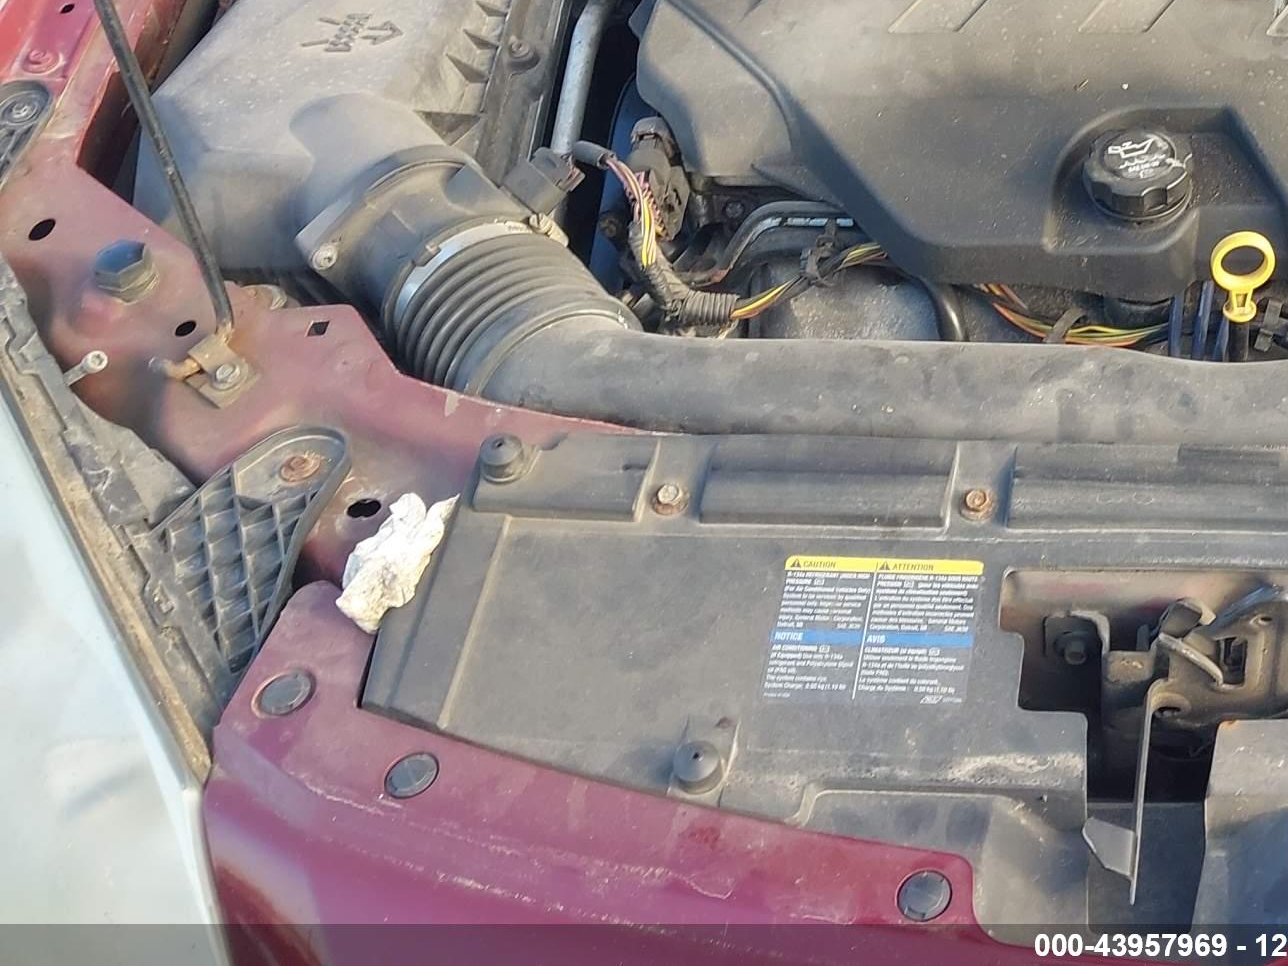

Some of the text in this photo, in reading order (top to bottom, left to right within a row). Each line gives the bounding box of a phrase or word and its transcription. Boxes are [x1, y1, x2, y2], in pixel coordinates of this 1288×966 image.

[892, 563, 934, 571] ATTENTION
[774, 632, 804, 641] NOTICE
[866, 635, 886, 644] AVIS
